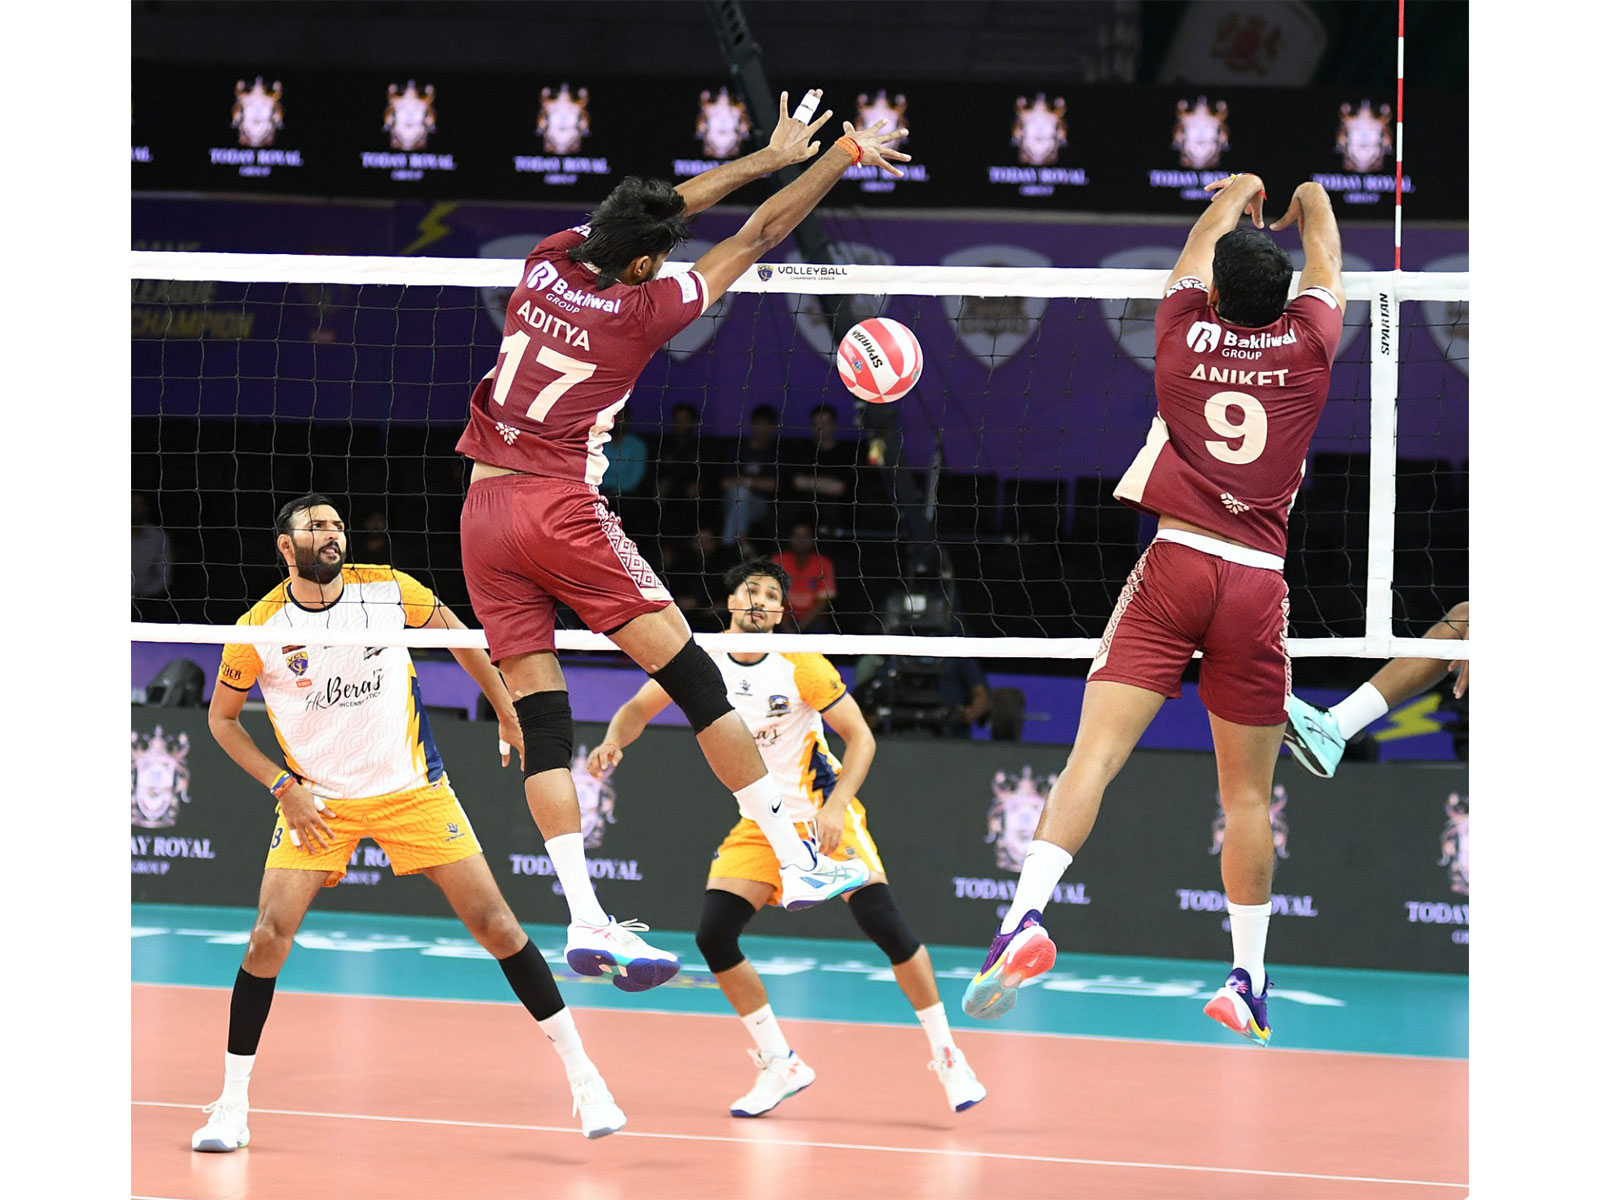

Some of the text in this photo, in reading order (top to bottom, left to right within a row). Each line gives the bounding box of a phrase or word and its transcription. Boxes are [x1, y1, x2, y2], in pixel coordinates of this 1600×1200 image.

[777, 266, 848, 276] VOLLEYBALL
[545, 292, 581, 314] GROUP
[552, 277, 622, 315] Bakliwal
[517, 300, 591, 351] ADITYA
[1223, 328, 1298, 349] Bakliwal
[1379, 293, 1390, 356] SPARTAN
[851, 329, 883, 369] SPARTAN
[1221, 348, 1262, 360] GROUP
[492, 329, 598, 423] 17
[1204, 390, 1268, 464] 9
[153, 836, 216, 859] ROYAL
